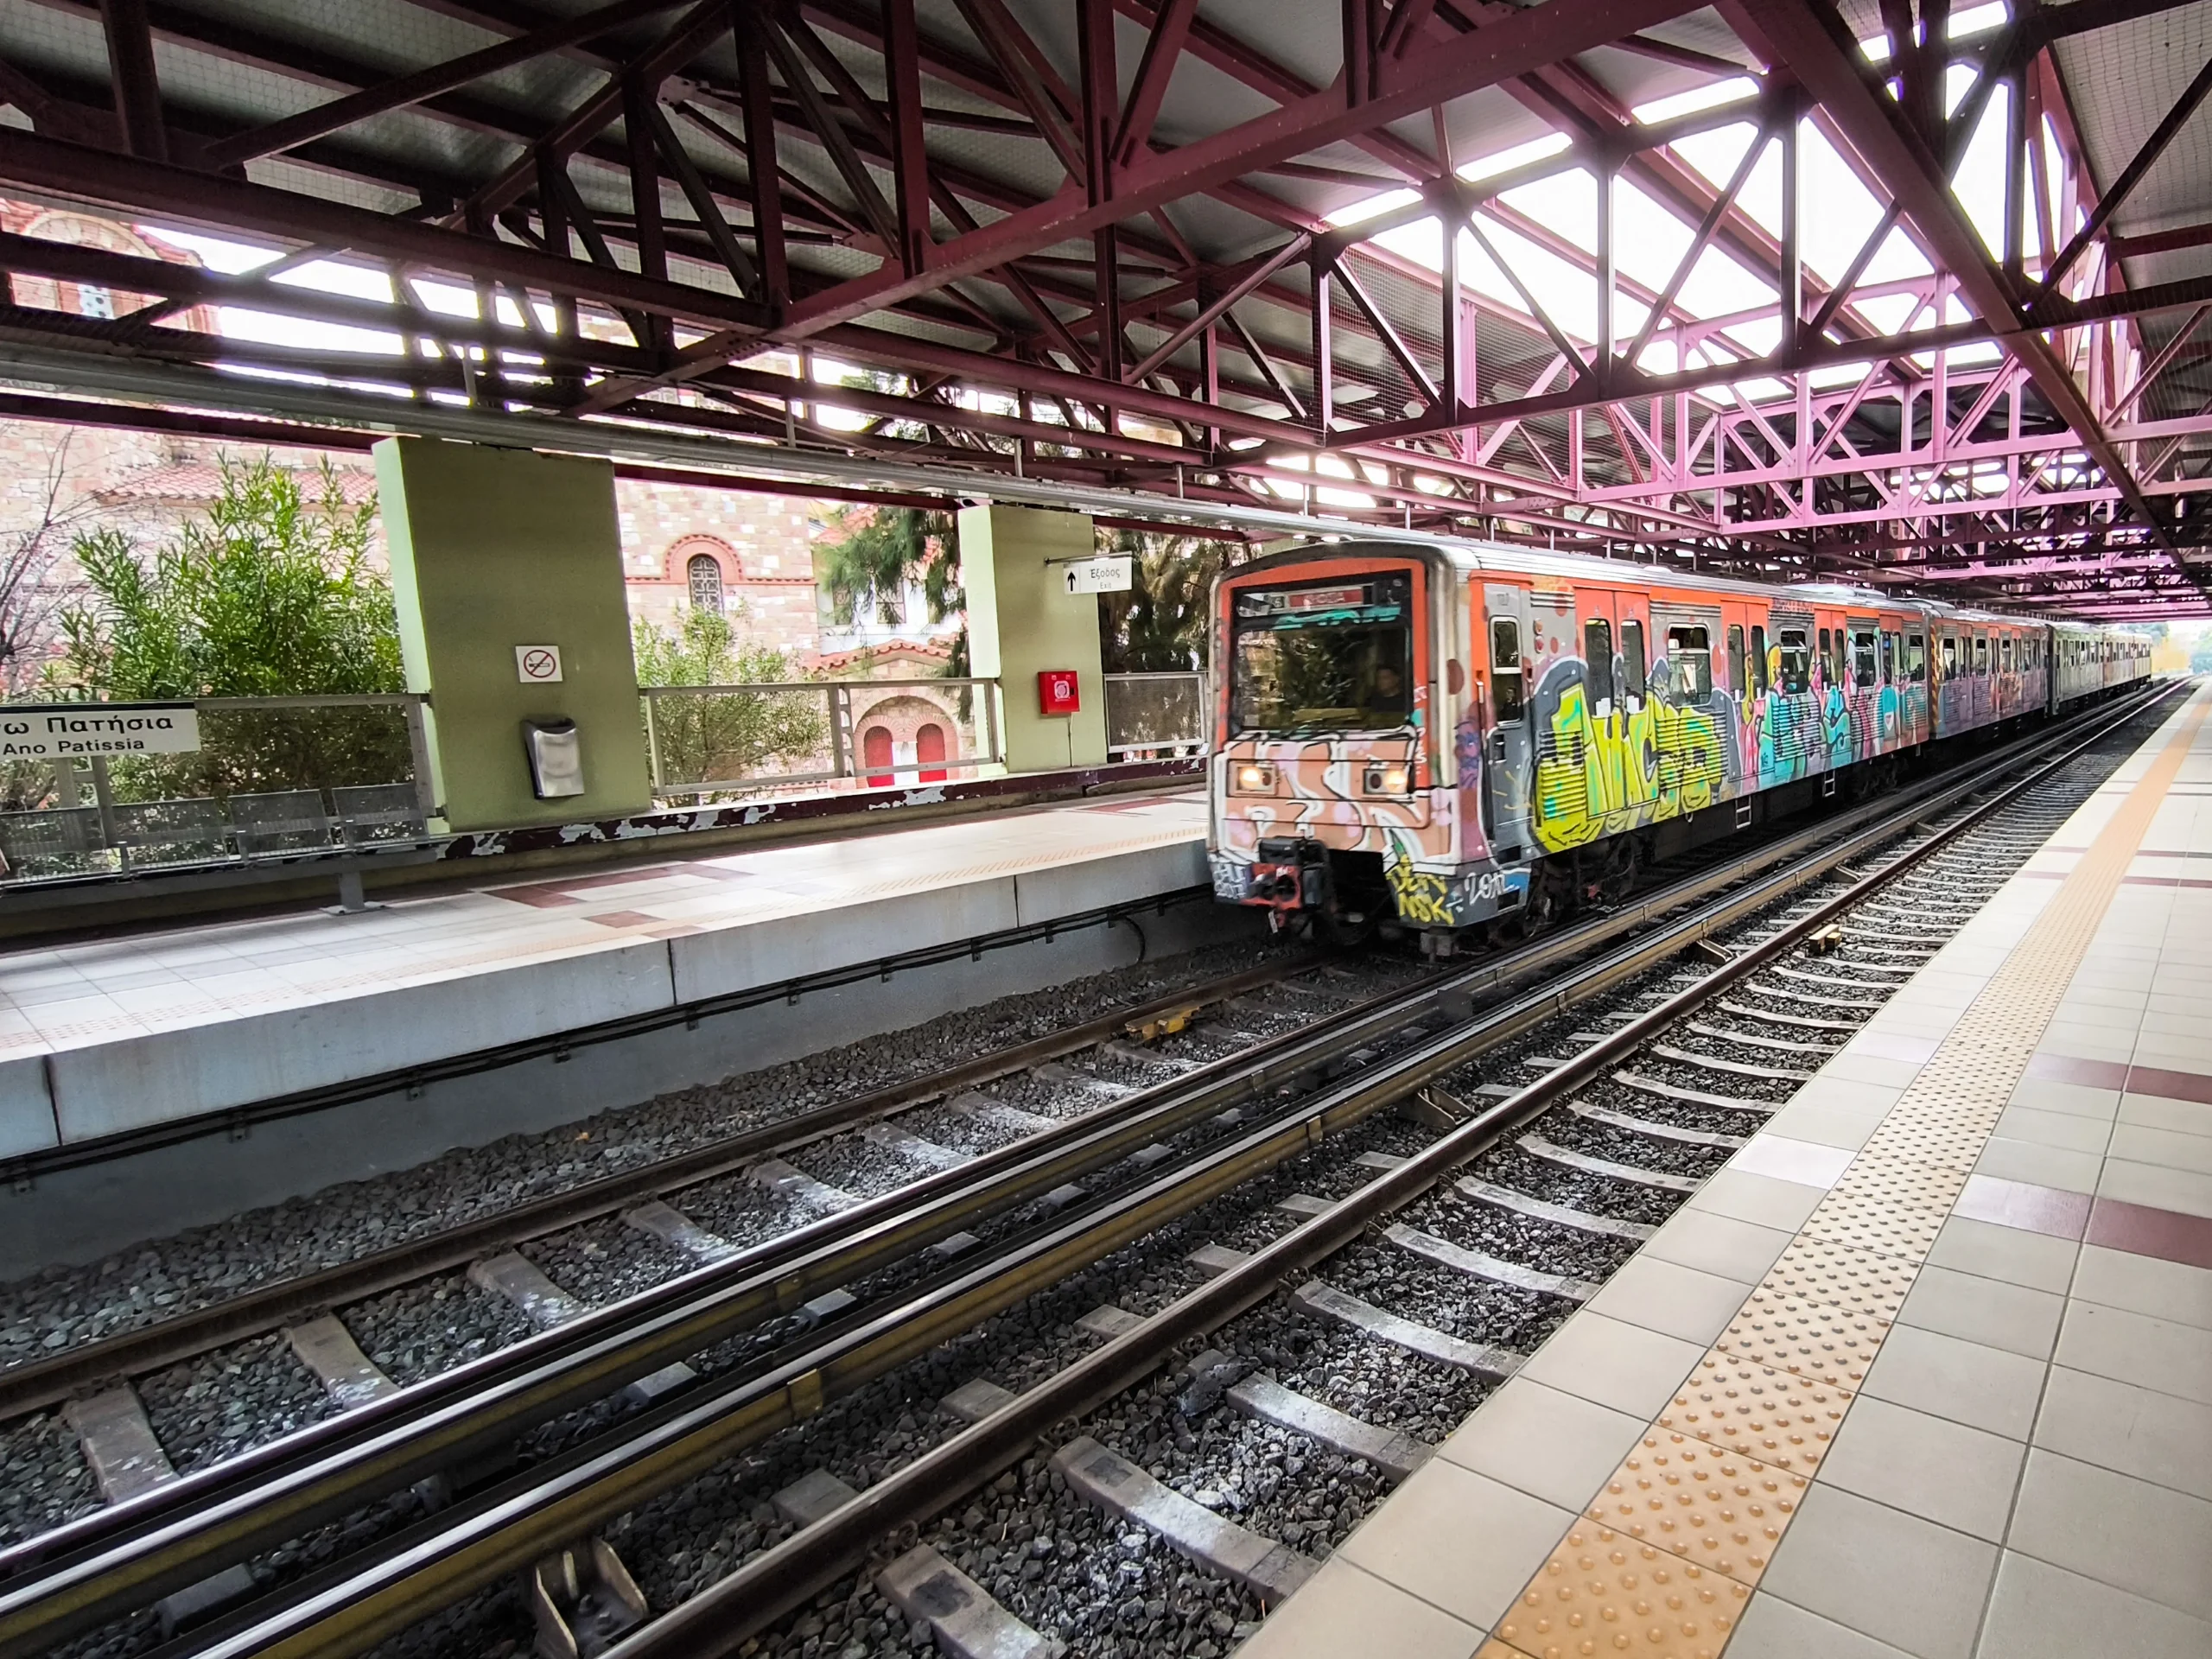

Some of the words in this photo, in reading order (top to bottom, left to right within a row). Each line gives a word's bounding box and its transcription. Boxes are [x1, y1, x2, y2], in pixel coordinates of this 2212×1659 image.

[0, 722, 29, 734] ω
[47, 715, 173, 734] Πατήσια
[3, 743, 47, 755] Ano
[58, 739, 144, 753] Patissia
